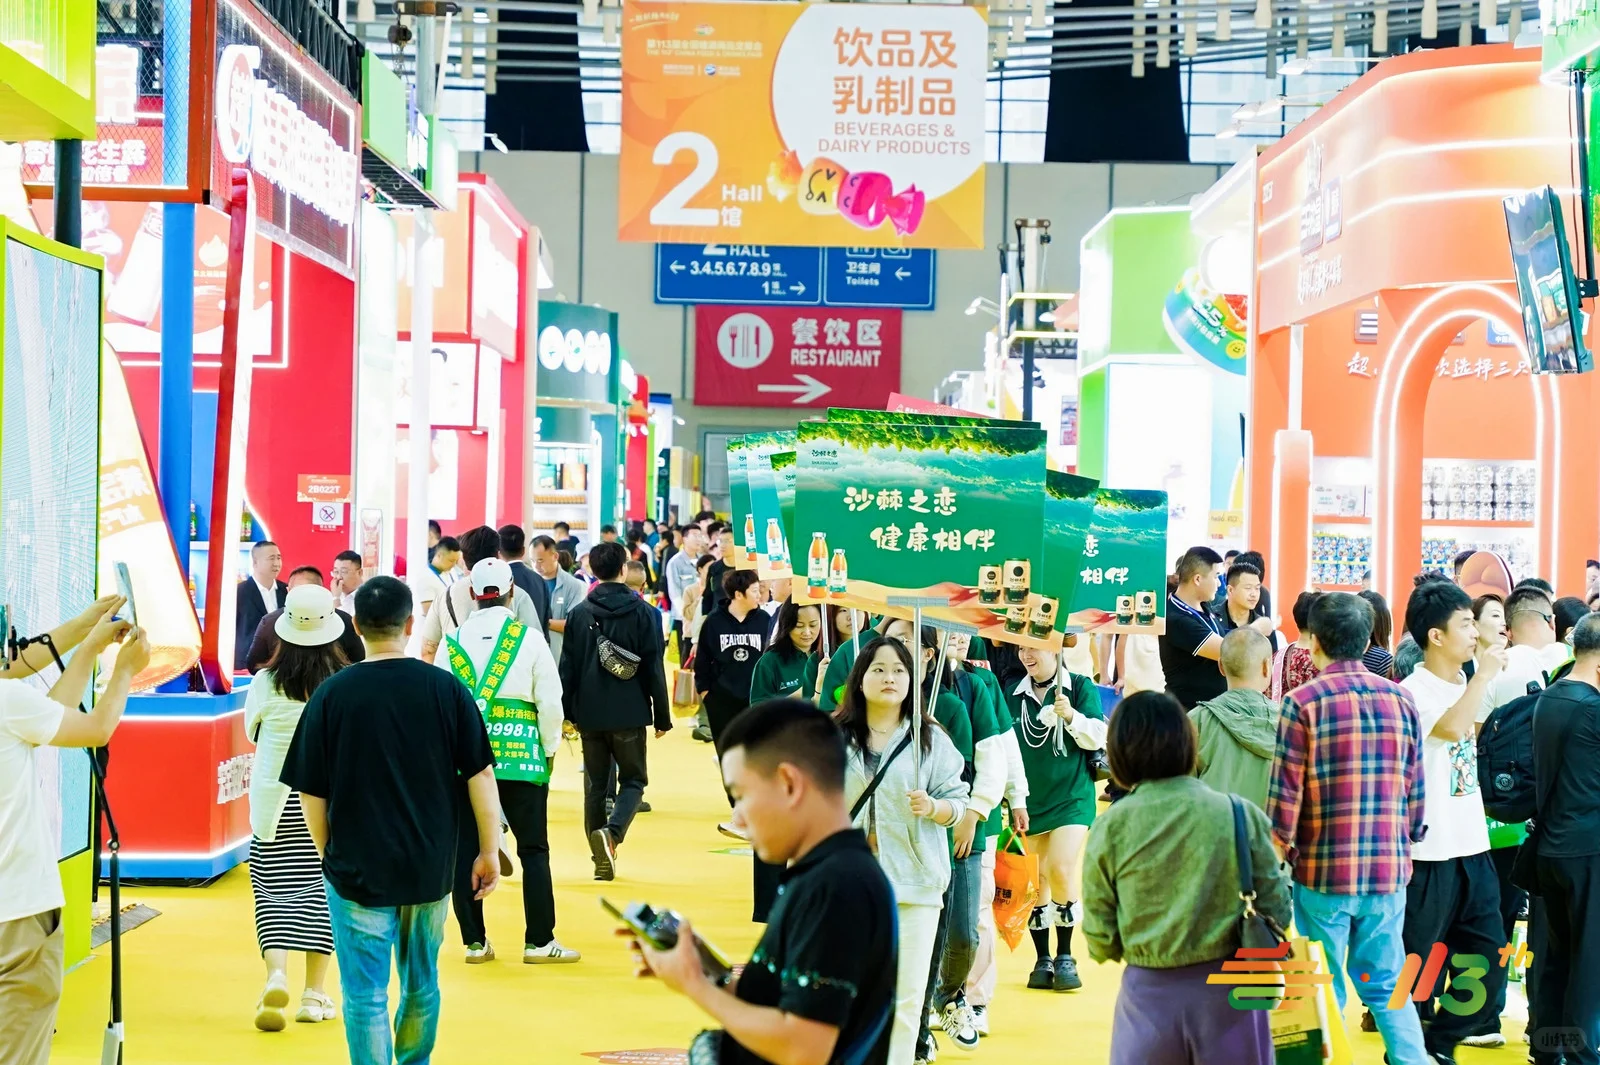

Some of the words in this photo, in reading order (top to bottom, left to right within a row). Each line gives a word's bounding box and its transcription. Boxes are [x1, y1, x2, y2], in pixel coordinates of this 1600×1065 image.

[833, 27, 958, 69] 饮品及
[832, 74, 956, 116] 乳制品
[834, 121, 940, 138] BEVERAGES
[943, 123, 956, 137] &
[818, 138, 871, 154] DAIRY
[876, 140, 971, 156] PRODUCTS
[649, 131, 720, 227] 2
[721, 183, 763, 202] Hall
[721, 205, 743, 228] 馆
[729, 245, 771, 257] HALL
[690, 260, 772, 277] 3.4.5.6.7.8.9
[846, 261, 881, 275] 卫生间
[762, 281, 770, 295] 1
[846, 276, 880, 286] Toilets
[791, 317, 882, 346] 餐饮区
[790, 348, 882, 368] RESTAURANT
[307, 485, 341, 493] 2B022T
[843, 486, 957, 516] 沙棘之恋
[870, 522, 995, 552] 健康相伴
[1083, 535, 1099, 558] 恋
[1080, 566, 1129, 585] 相伴
[489, 705, 537, 720] 爆好酒招
